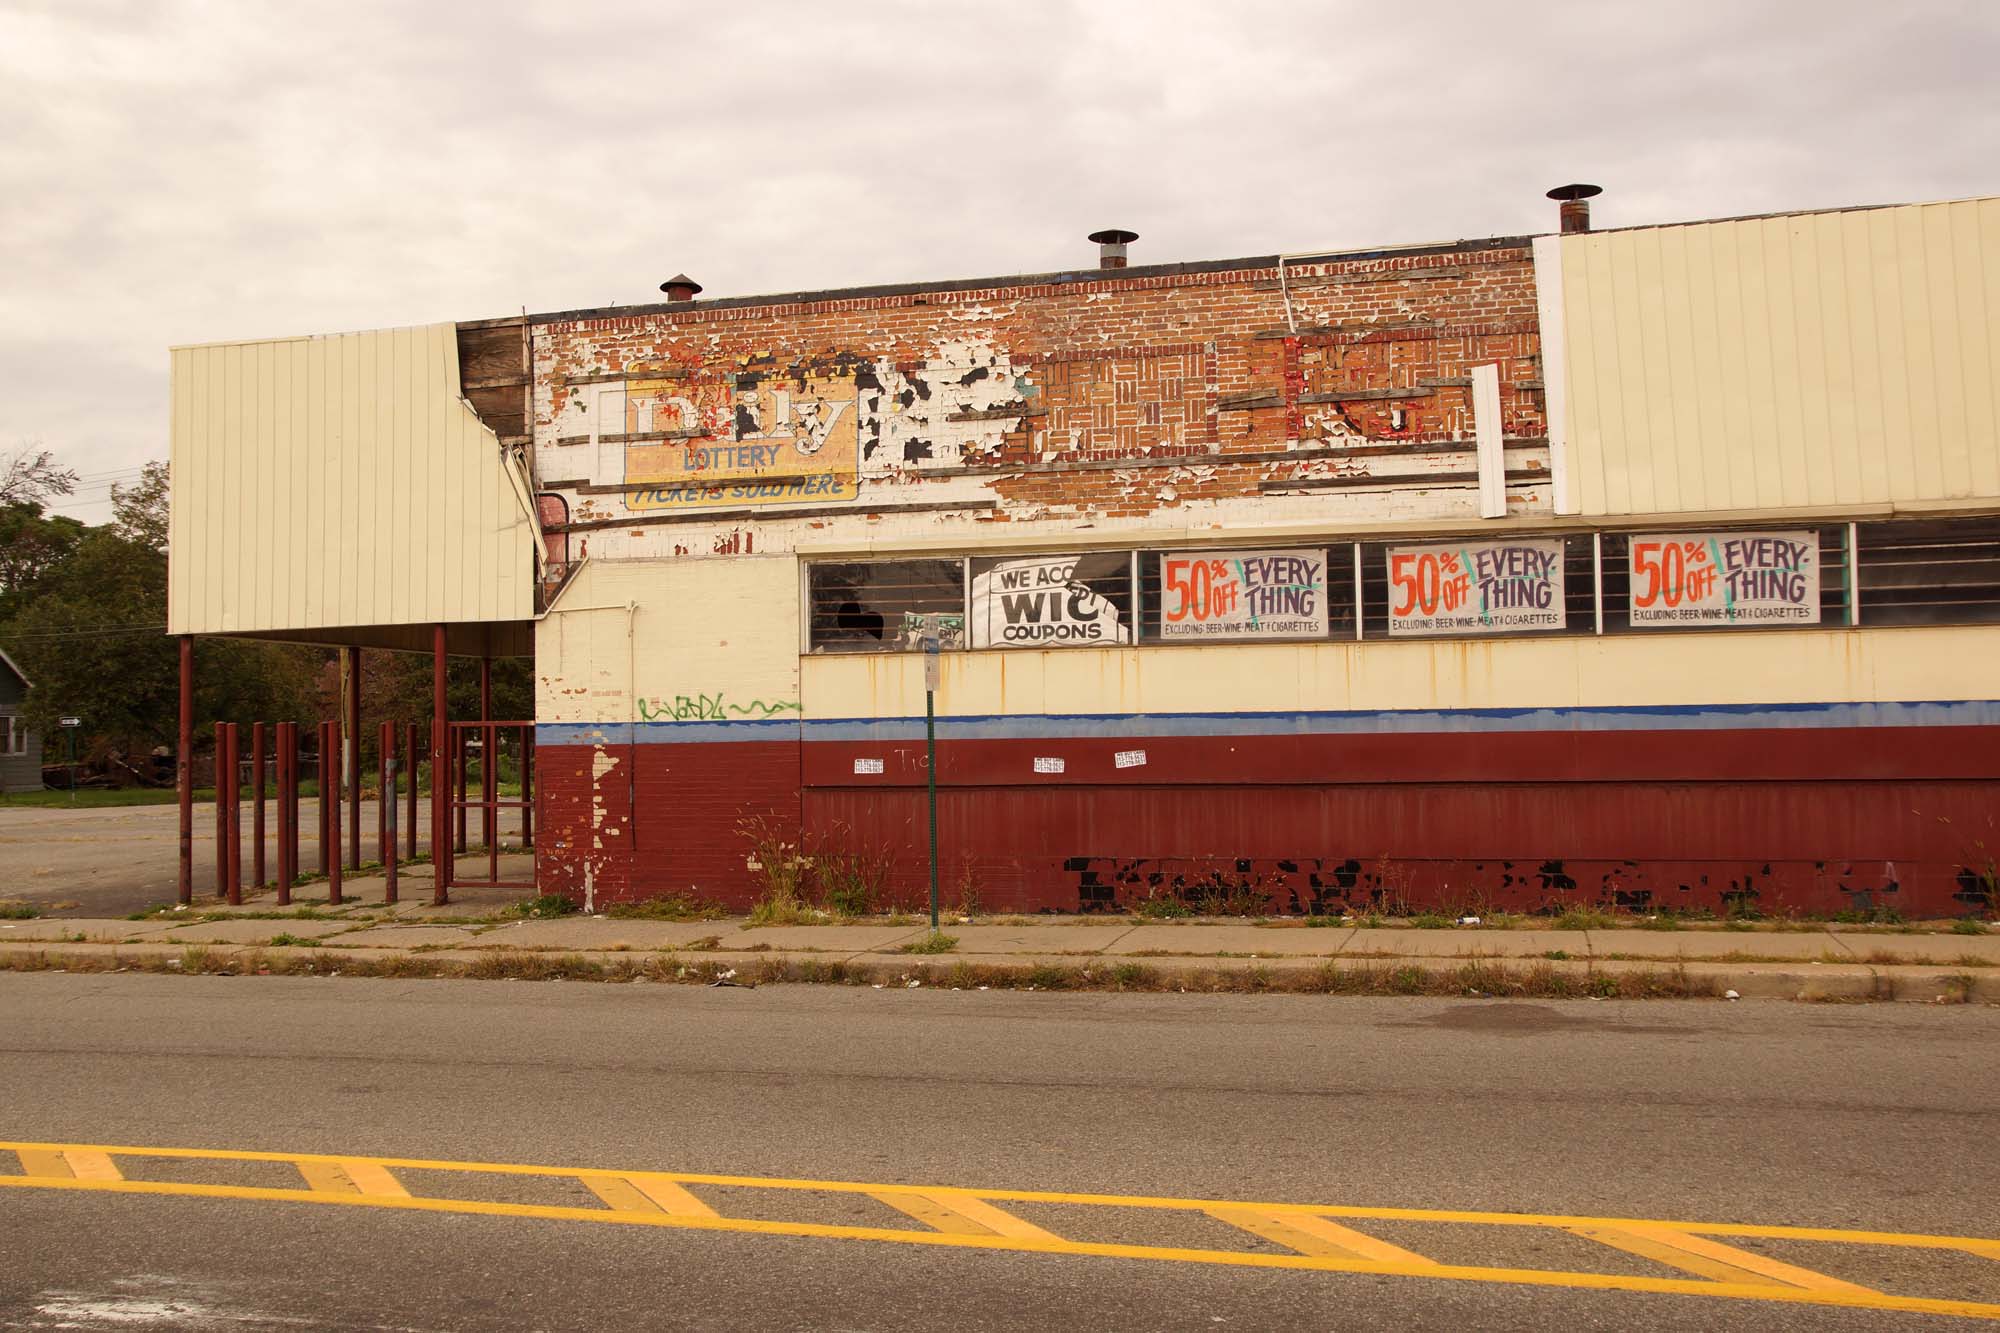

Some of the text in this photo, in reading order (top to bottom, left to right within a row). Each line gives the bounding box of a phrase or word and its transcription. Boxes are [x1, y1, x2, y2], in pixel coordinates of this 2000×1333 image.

[683, 444, 781, 471] LOTTERY
[1000, 570, 1031, 590] WE
[1166, 559, 1239, 622] 50% OFF
[1391, 551, 1471, 617] 50% OFF
[1634, 541, 1717, 608] 50% OFF
[1724, 568, 1806, 604] THING
[1001, 591, 1099, 624] WIC
[1245, 585, 1315, 618] THING
[1478, 577, 1552, 610] THING
[1271, 620, 1319, 632] CIGARETTES
[1504, 613, 1558, 626] CIGARETTES
[1754, 606, 1811, 619] CIGARETTES
[1003, 623, 1102, 641] COUPONS
